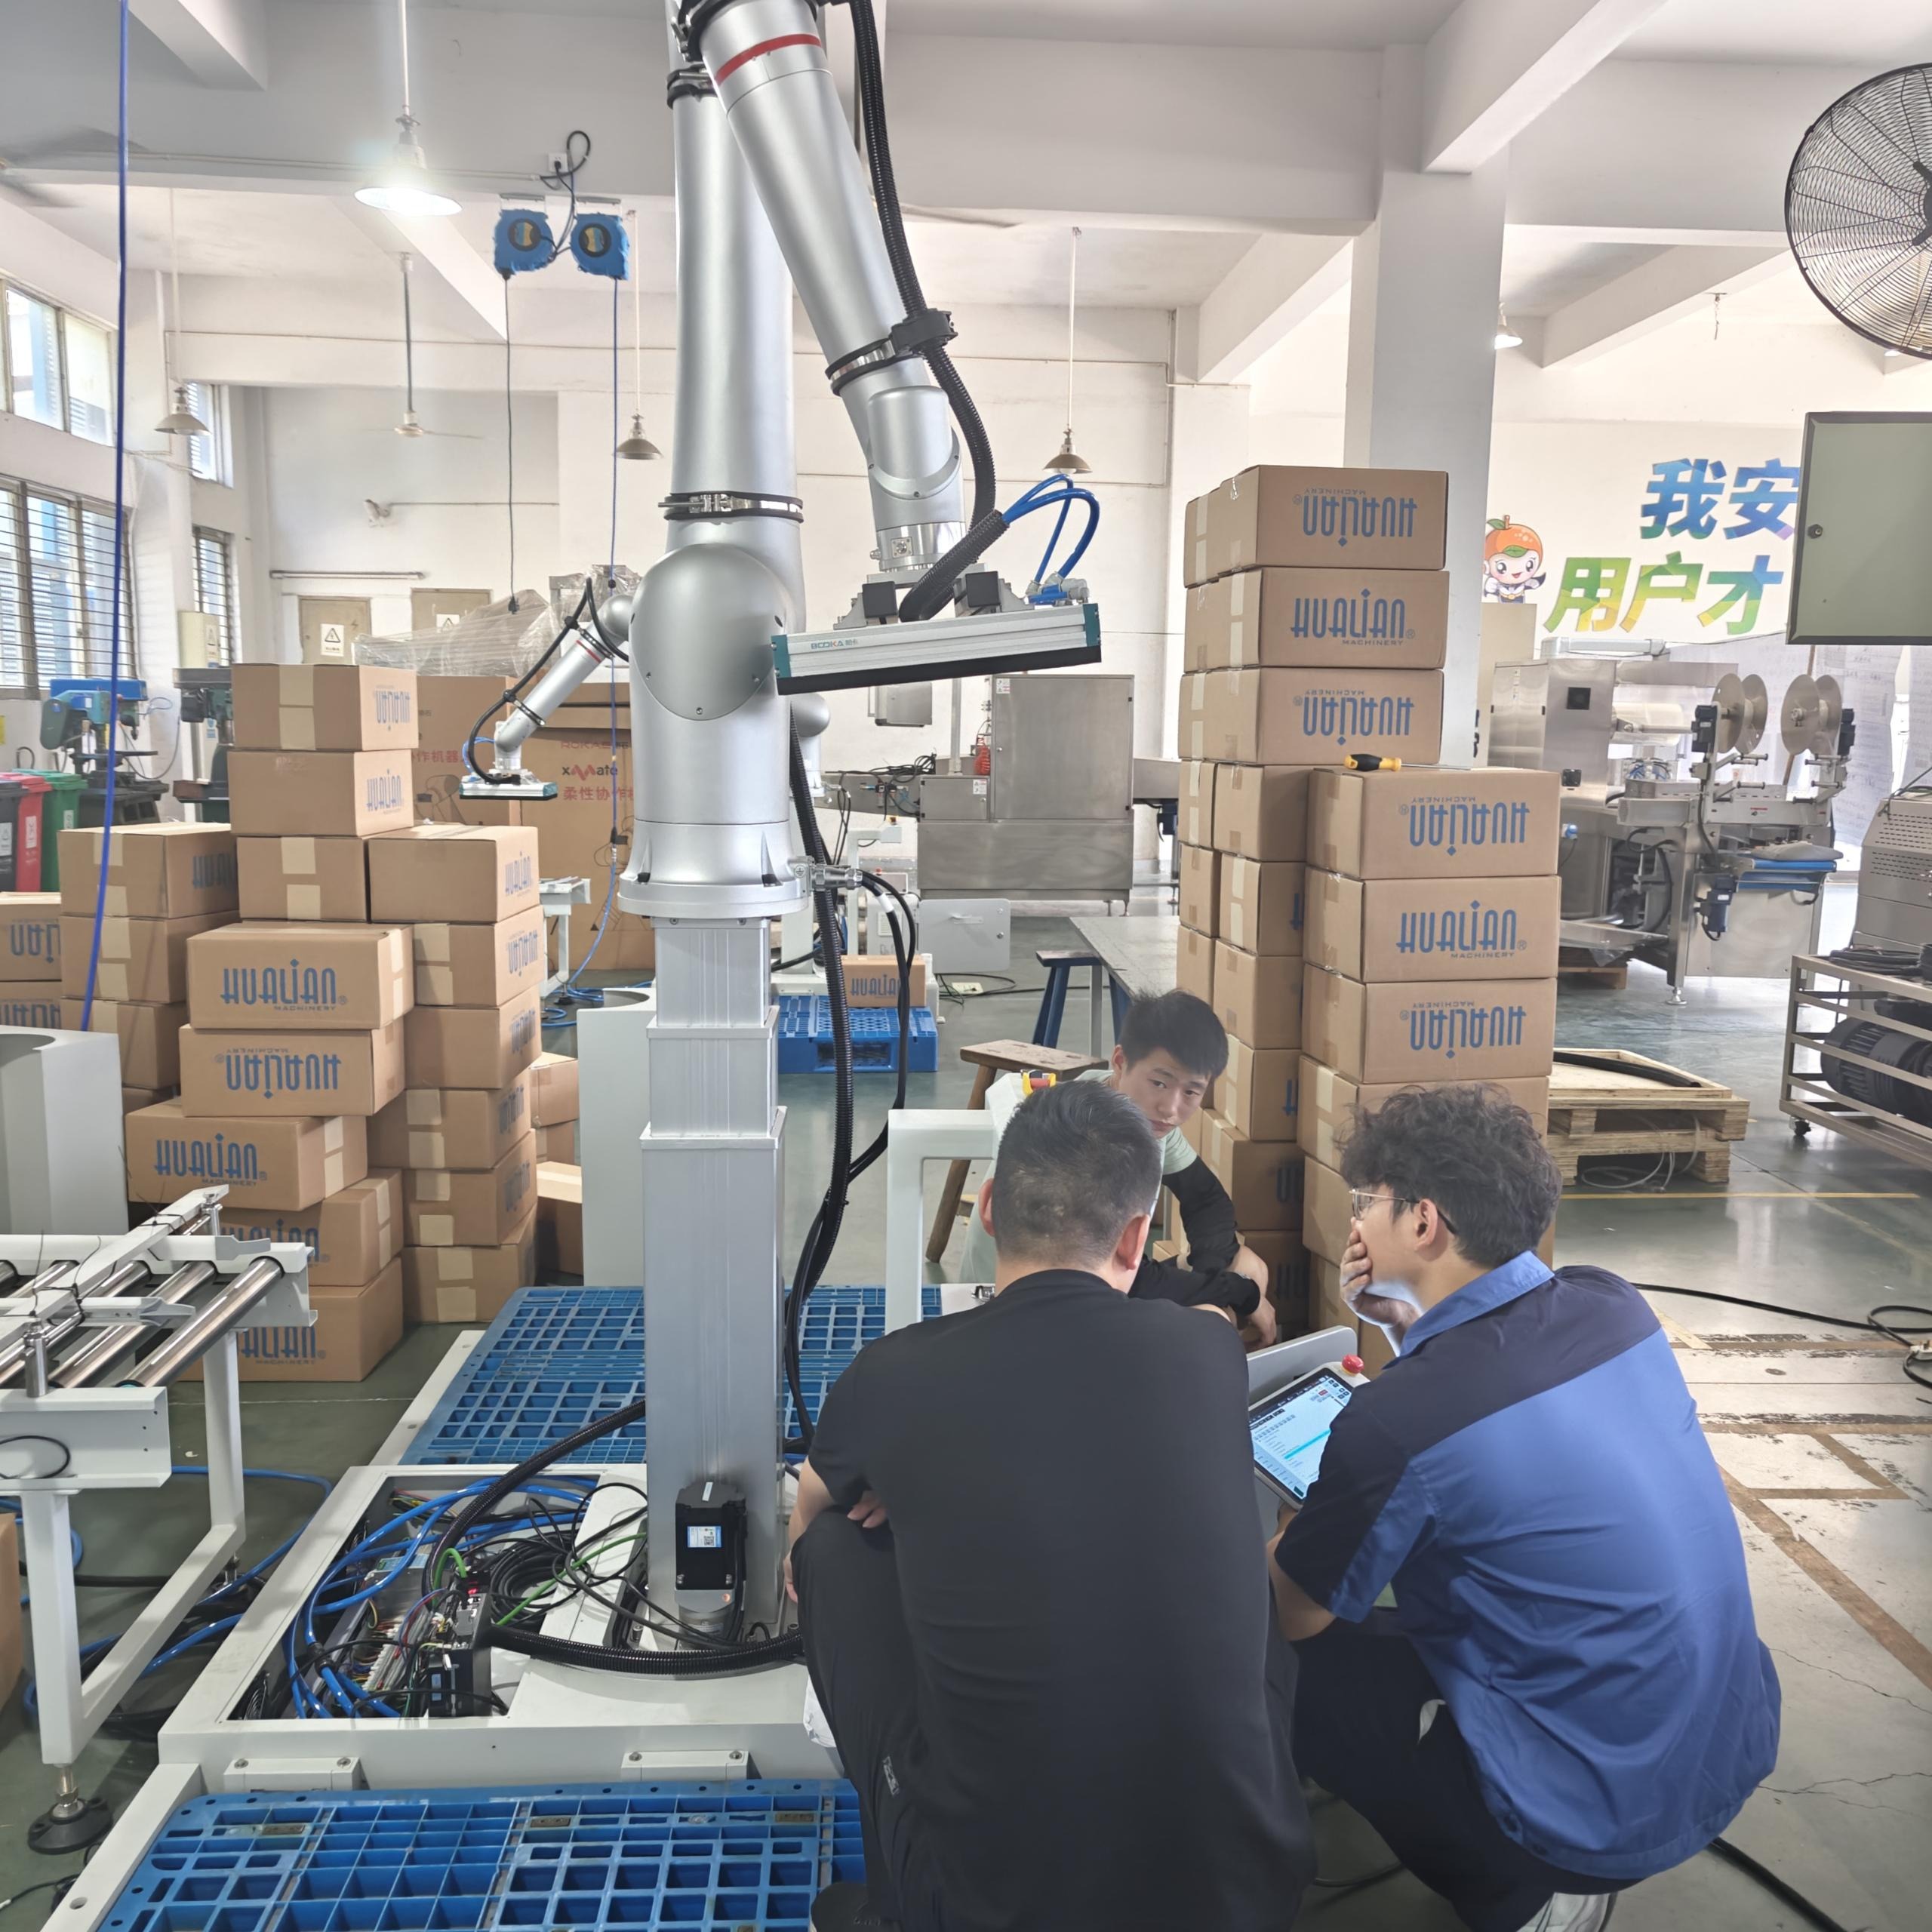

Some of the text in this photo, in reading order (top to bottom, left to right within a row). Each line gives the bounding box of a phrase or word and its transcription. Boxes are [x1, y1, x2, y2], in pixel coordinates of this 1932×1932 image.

[1303, 495, 1417, 547] HUALIAN
[1290, 588, 1406, 638] HUALIAN
[1543, 551, 1784, 635] 用户才
[1303, 696, 1415, 746] HUALIAN
[1409, 802, 1531, 857] HUALIAN
[1396, 900, 1518, 954] HUALIAN
[220, 958, 337, 1005] HUALIAN
[1410, 1005, 1527, 1060] HUALIAN
[226, 1054, 342, 1100] HUALIAN
[154, 1133, 258, 1180] HUALIAN
